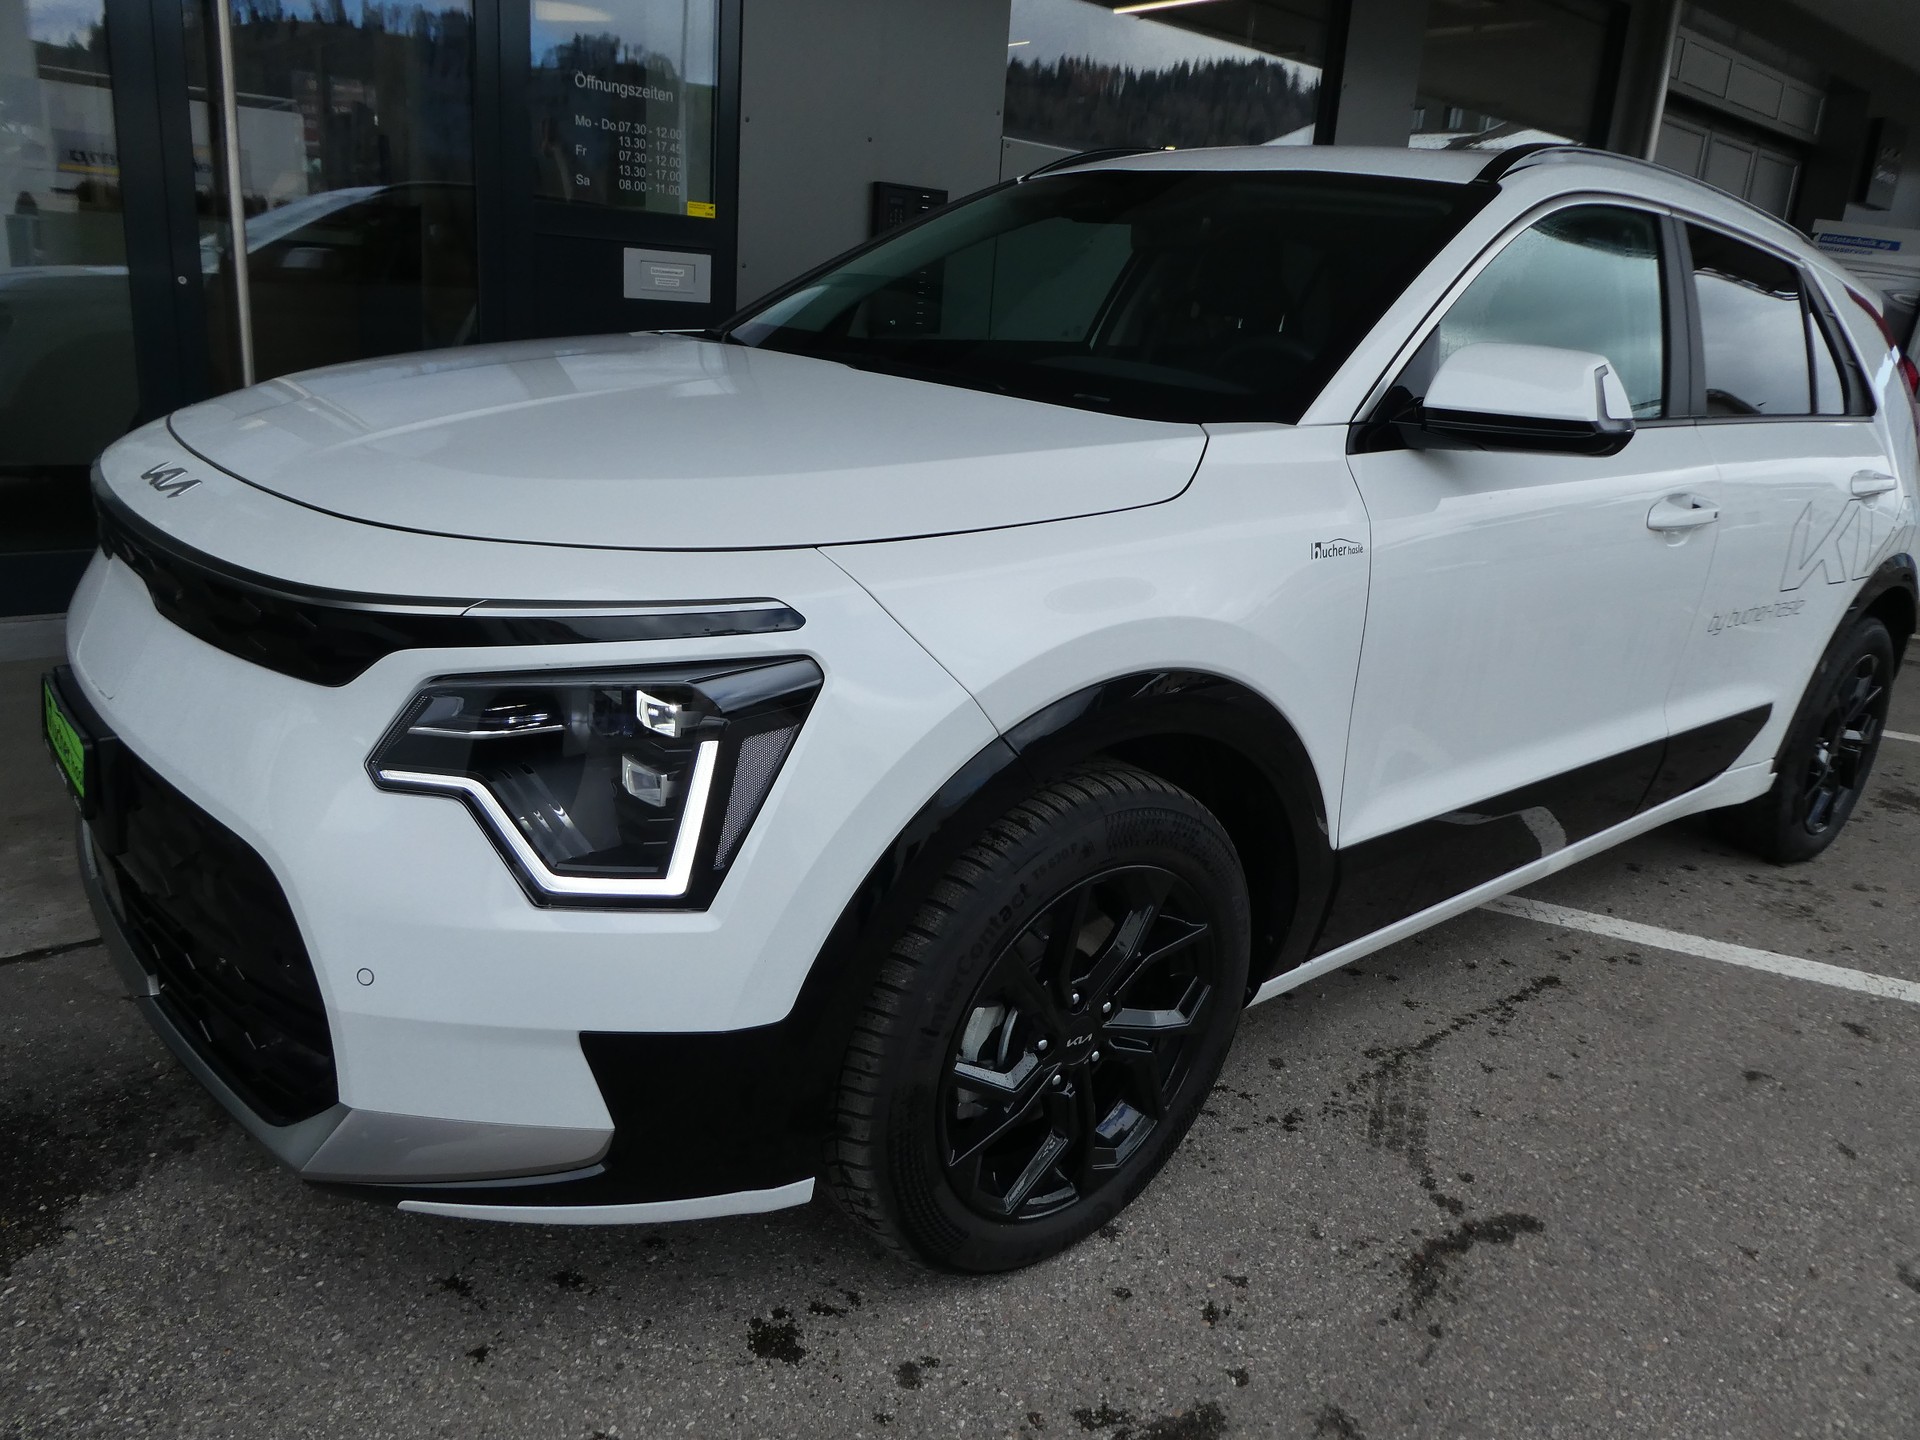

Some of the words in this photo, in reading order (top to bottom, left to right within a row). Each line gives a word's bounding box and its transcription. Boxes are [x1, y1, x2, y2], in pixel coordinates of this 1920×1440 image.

[575, 70, 673, 102] Öffnungszeiten
[575, 115, 591, 128] Mo
[601, 118, 616, 131] Do
[618, 121, 647, 134] 07.30
[655, 127, 682, 140] 12.00
[619, 136, 646, 150] 13.30
[575, 144, 587, 156] Fr
[619, 150, 647, 163] 07.30
[656, 156, 682, 168] 12.00
[619, 165, 646, 178] 13.30
[656, 170, 682, 182] 17.00
[575, 174, 590, 186] Sa
[619, 179, 647, 192] 08.00
[656, 184, 681, 196] 11.00
[140, 461, 203, 498] KIA
[1348, 545, 1364, 555] hasle
[1066, 1033, 1093, 1047] KIA
